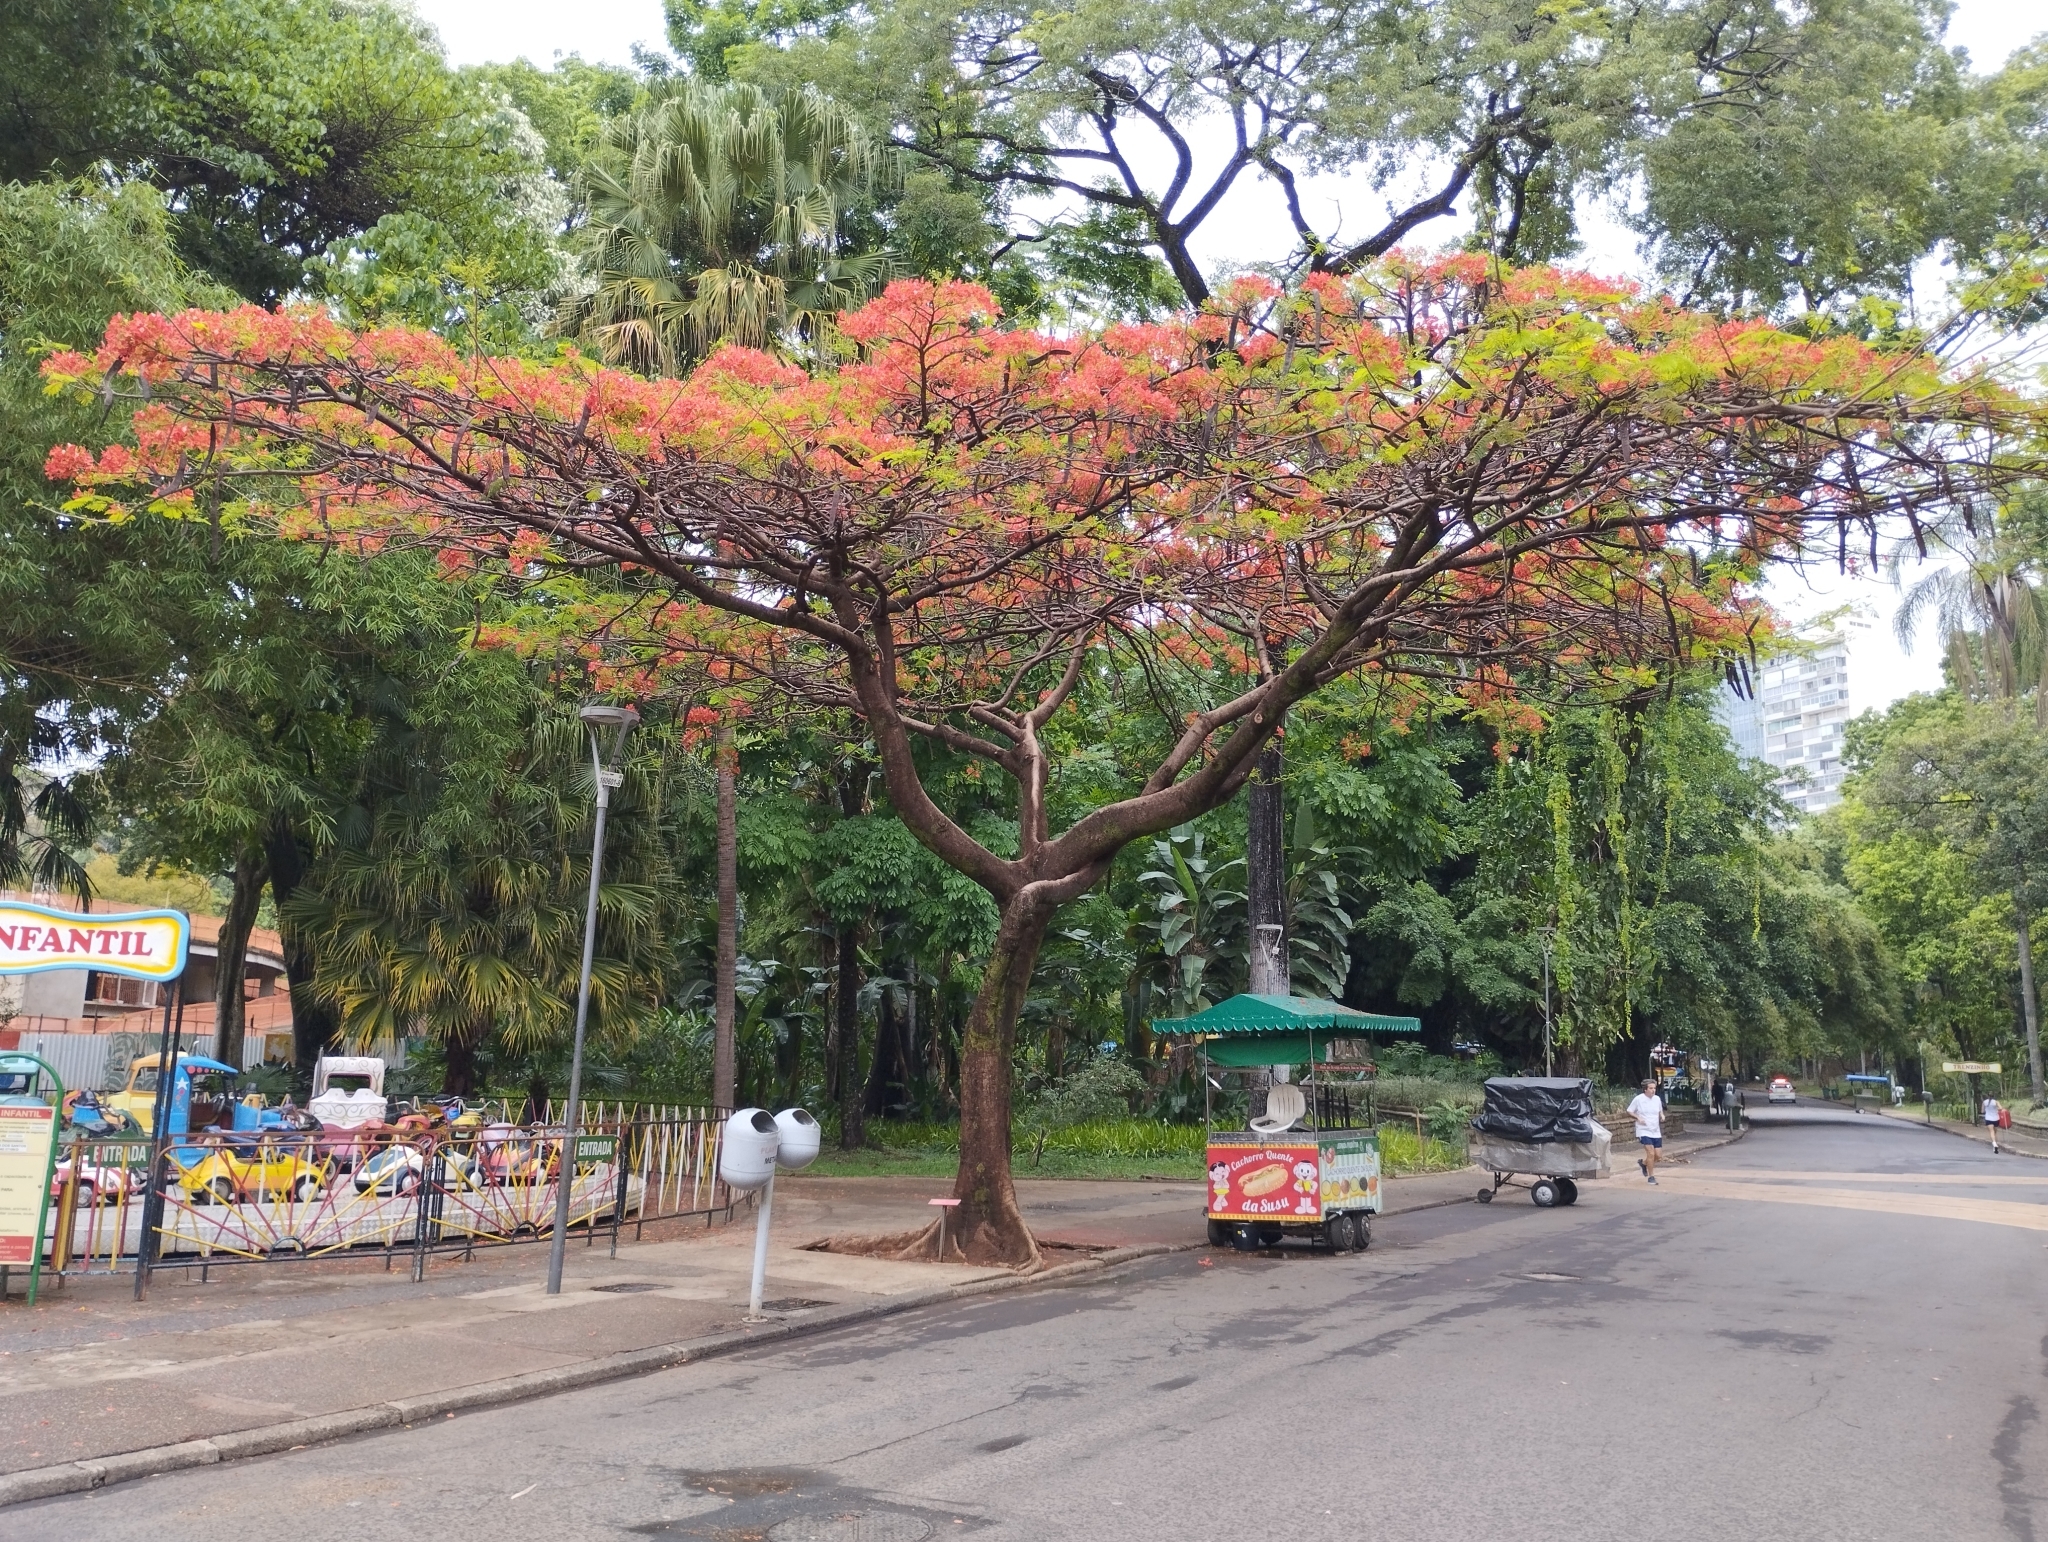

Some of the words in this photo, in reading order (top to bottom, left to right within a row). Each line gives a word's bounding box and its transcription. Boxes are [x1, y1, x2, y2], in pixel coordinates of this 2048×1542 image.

[1, 1109, 42, 1118] INFANTIL
[578, 1141, 612, 1157] ENTRADA
[1231, 1153, 1264, 1171] Cachorro
[1265, 1150, 1294, 1163] Quente
[1242, 1199, 1258, 1213] da
[1260, 1197, 1290, 1213] Susu
